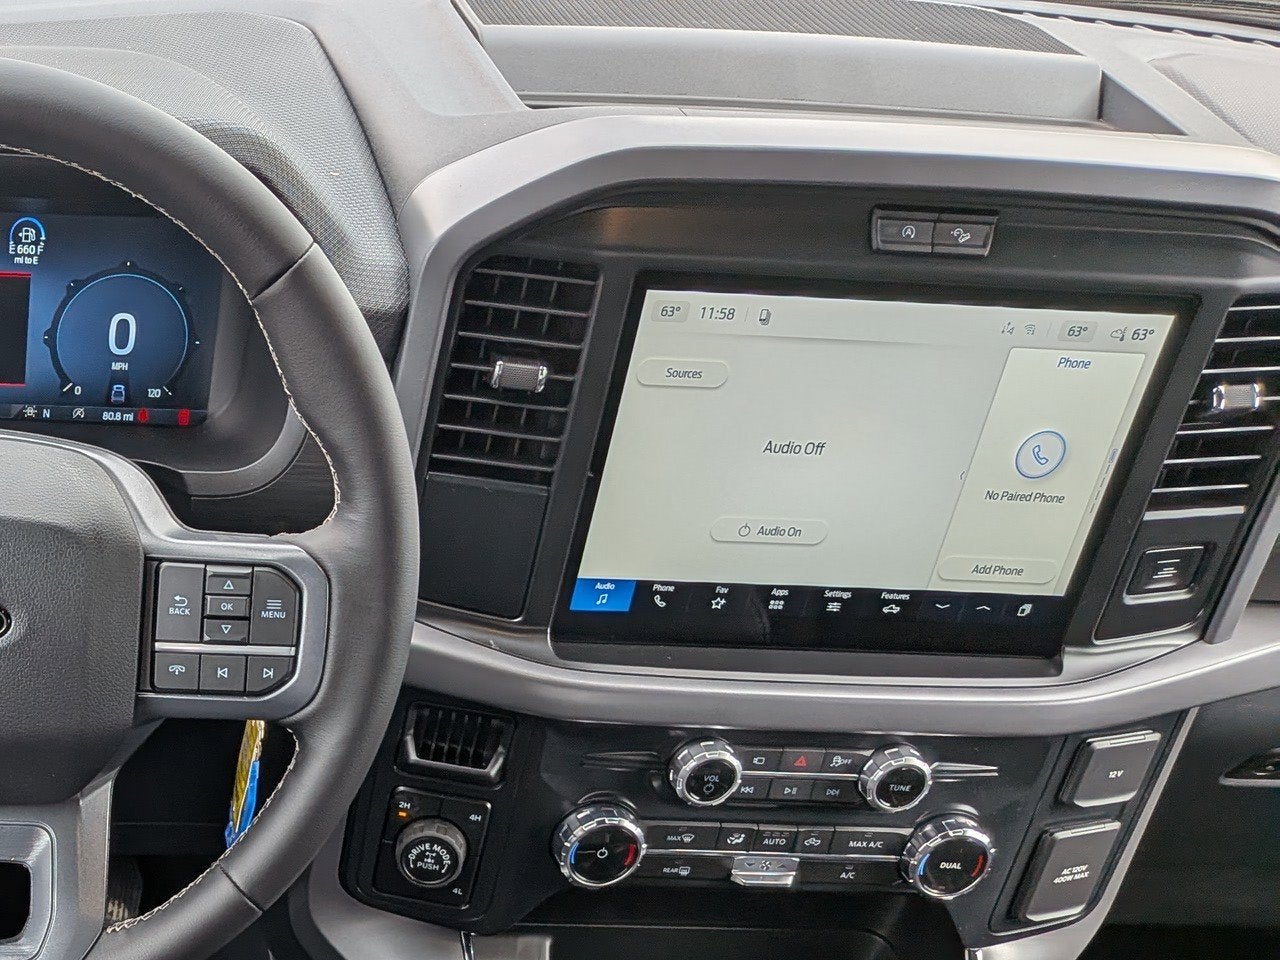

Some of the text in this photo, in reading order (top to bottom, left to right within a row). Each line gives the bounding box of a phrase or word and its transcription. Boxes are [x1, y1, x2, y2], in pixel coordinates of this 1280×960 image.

[17, 245, 35, 254] 660
[33, 257, 38, 265] E
[699, 306, 736, 321] 11:58
[109, 313, 136, 355] 0
[112, 362, 128, 371] MPH
[1057, 357, 1092, 370] Phone
[665, 367, 703, 379] Sources
[74, 386, 81, 395] 0
[148, 389, 161, 398] 120
[43, 409, 50, 418] N
[103, 412, 121, 421] 80.8
[763, 440, 827, 456] Audio Off
[984, 490, 1065, 504] No Paired Phone
[757, 525, 802, 537] Audio On
[971, 564, 1024, 577] Add Phone
[595, 582, 615, 590] Audio
[652, 584, 675, 593] Phone
[715, 586, 729, 594] Fav
[771, 588, 789, 597] Apps
[824, 590, 852, 599] Settings
[881, 592, 910, 601] Features
[221, 603, 233, 611] OK
[168, 608, 191, 616] BACK
[261, 611, 286, 619] MENU
[704, 775, 719, 783] VOL
[889, 784, 912, 792] TUNE
[398, 801, 411, 809] 2H
[469, 814, 481, 822] 4H
[763, 838, 786, 846] AUTO
[848, 840, 884, 849] MAX A/C
[408, 842, 451, 865] DRIVE MODE
[417, 861, 439, 871] PUSH
[939, 862, 962, 870] DUAL
[840, 871, 856, 880] A/C
[452, 887, 463, 895] 4L
